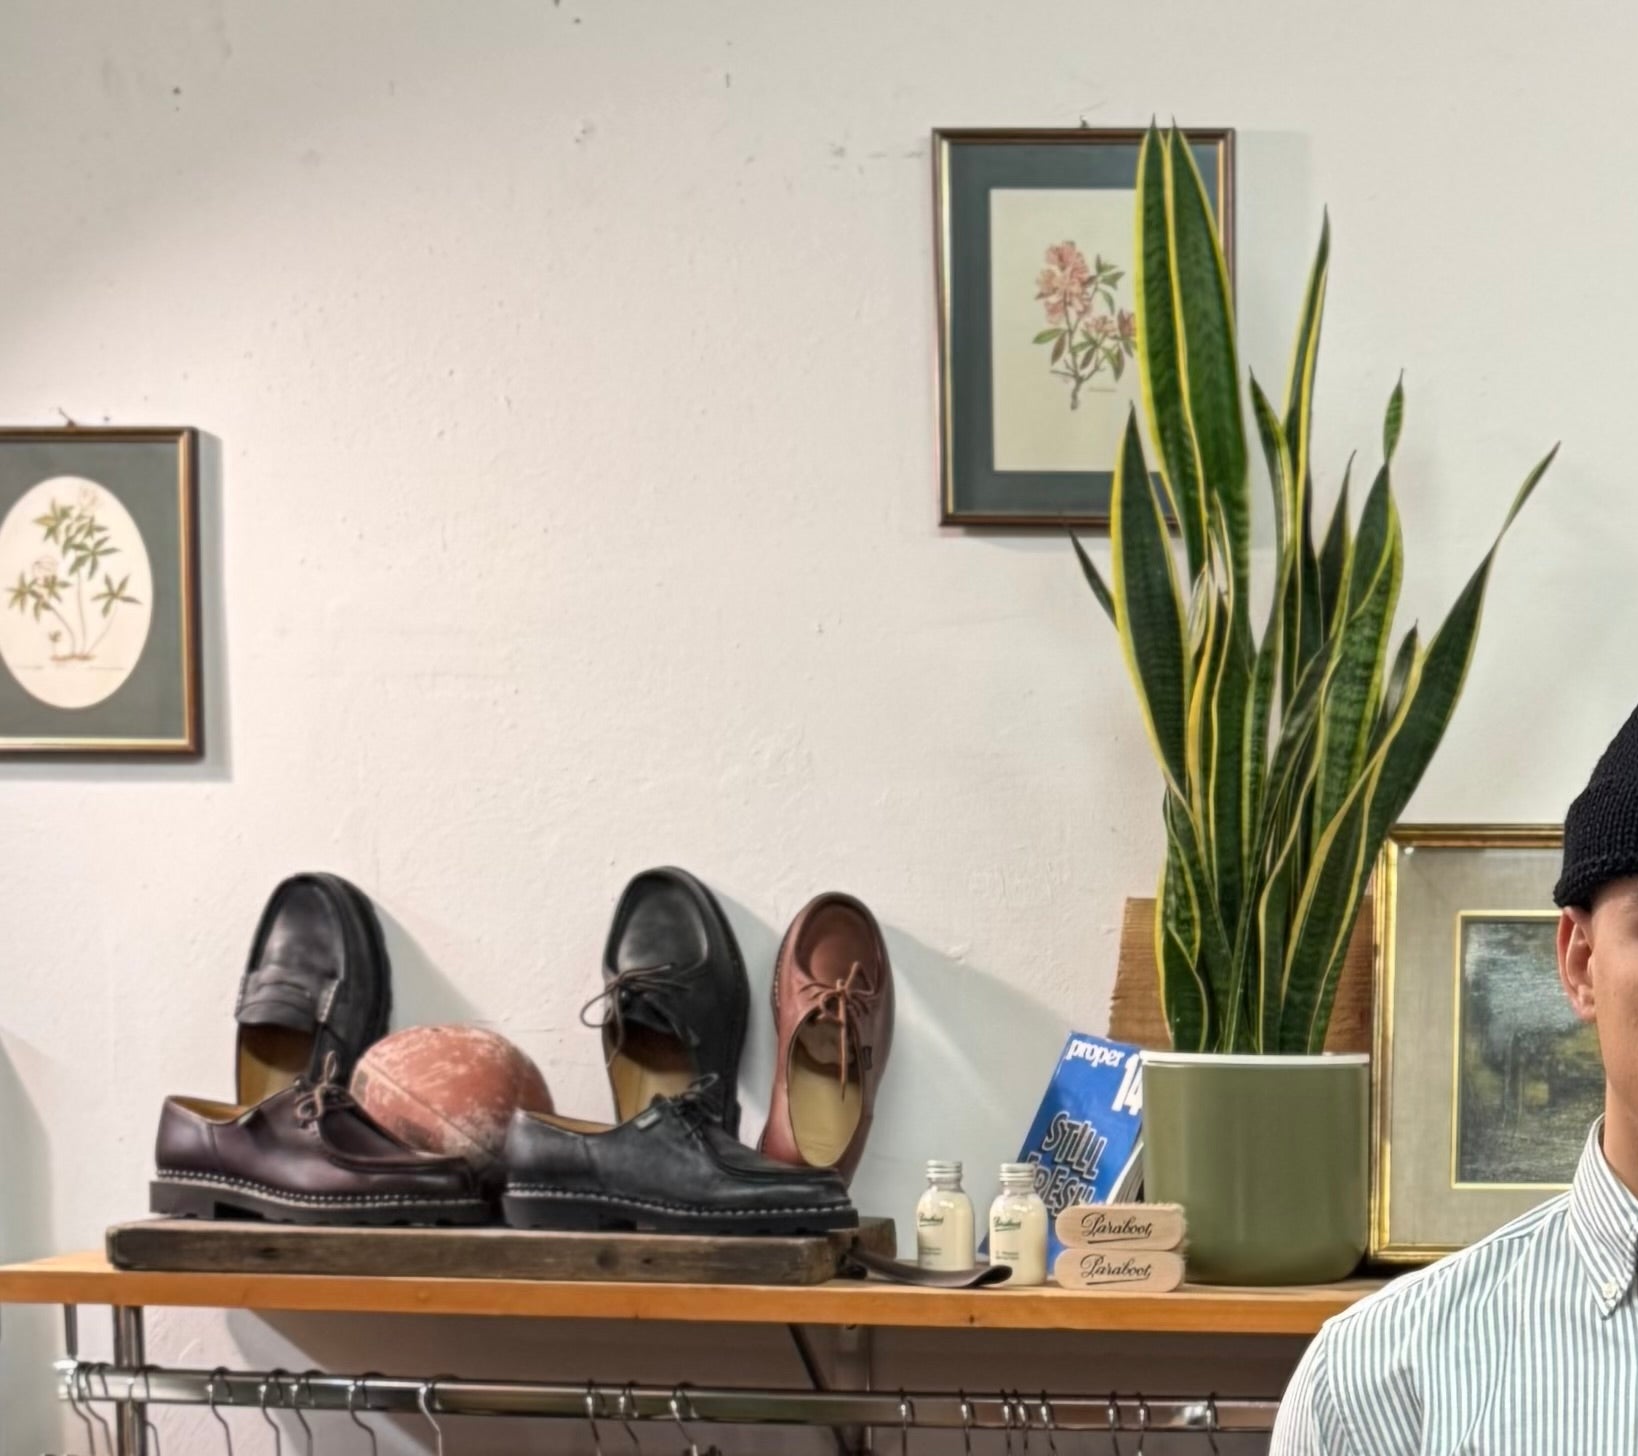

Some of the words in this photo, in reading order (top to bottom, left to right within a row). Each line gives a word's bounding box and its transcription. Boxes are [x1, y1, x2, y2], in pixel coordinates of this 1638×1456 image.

[1065, 1039, 1125, 1068] proper
[1111, 1052, 1144, 1116] 14
[1042, 1111, 1107, 1181] STILL
[1027, 1151, 1097, 1217] RESH
[1081, 1212, 1153, 1244] Paraboot
[1080, 1253, 1152, 1285] Paraboot
